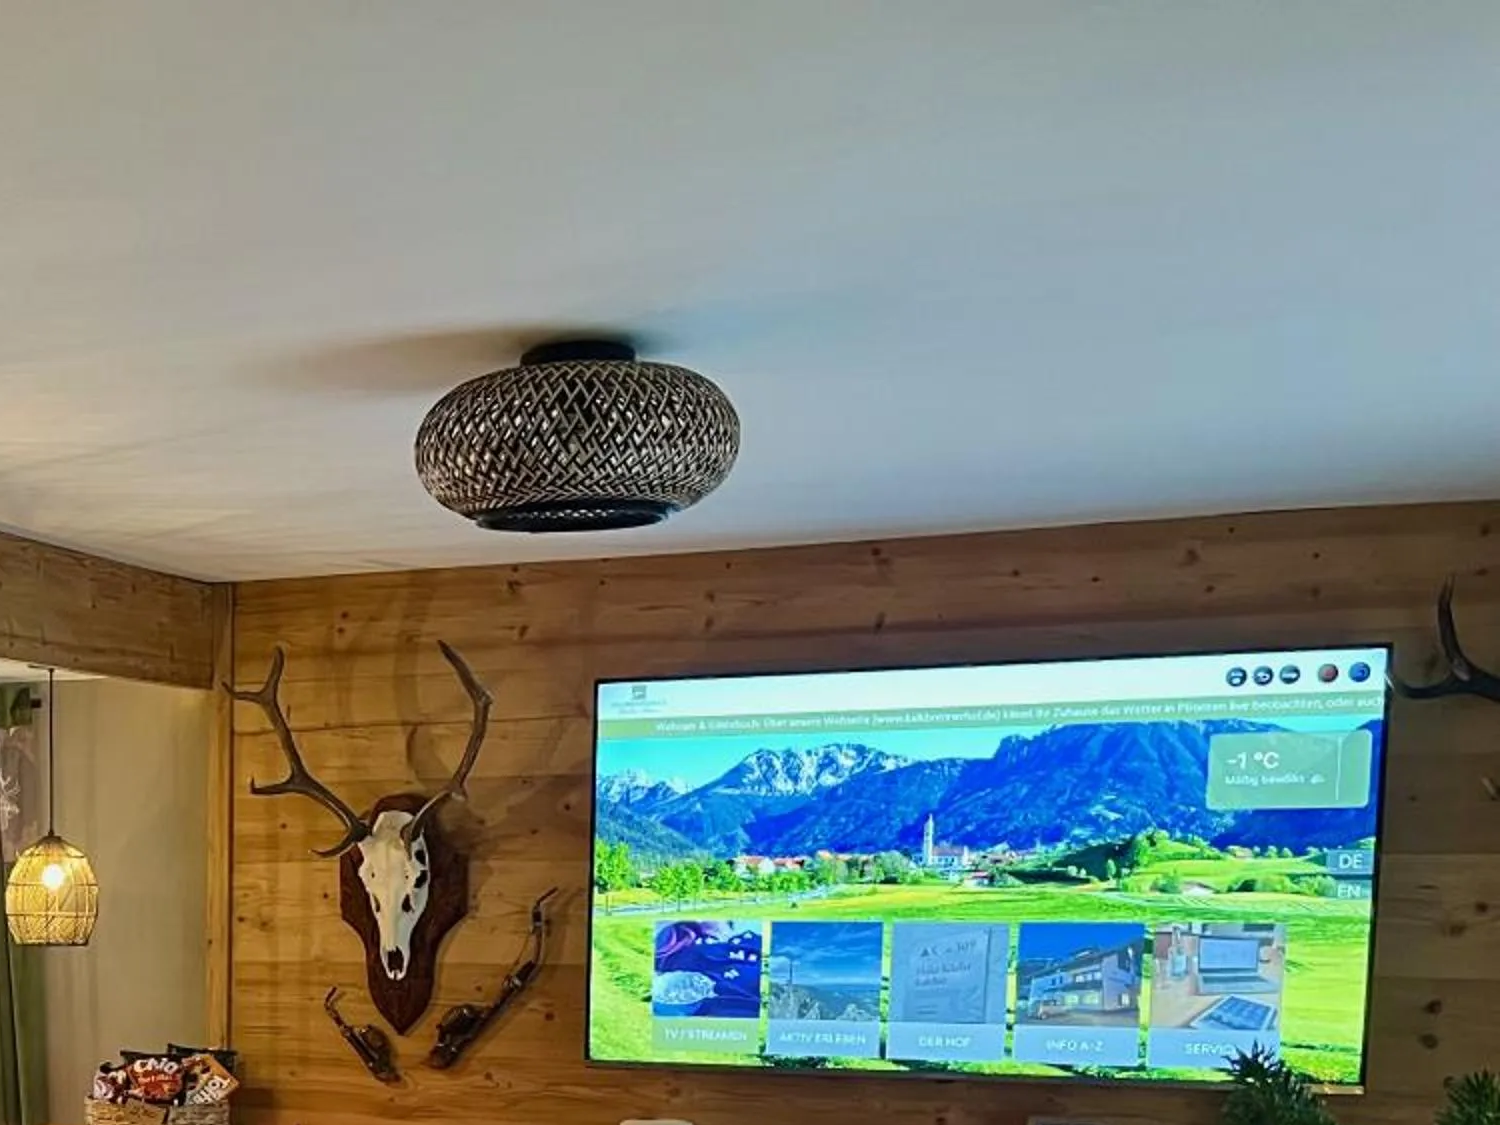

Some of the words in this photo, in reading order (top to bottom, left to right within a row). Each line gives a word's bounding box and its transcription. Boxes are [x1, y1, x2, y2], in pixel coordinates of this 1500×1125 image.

[1226, 752, 1248, 769] -1
[1338, 854, 1364, 870] DE
[1184, 1042, 1240, 1056] SERVIC
